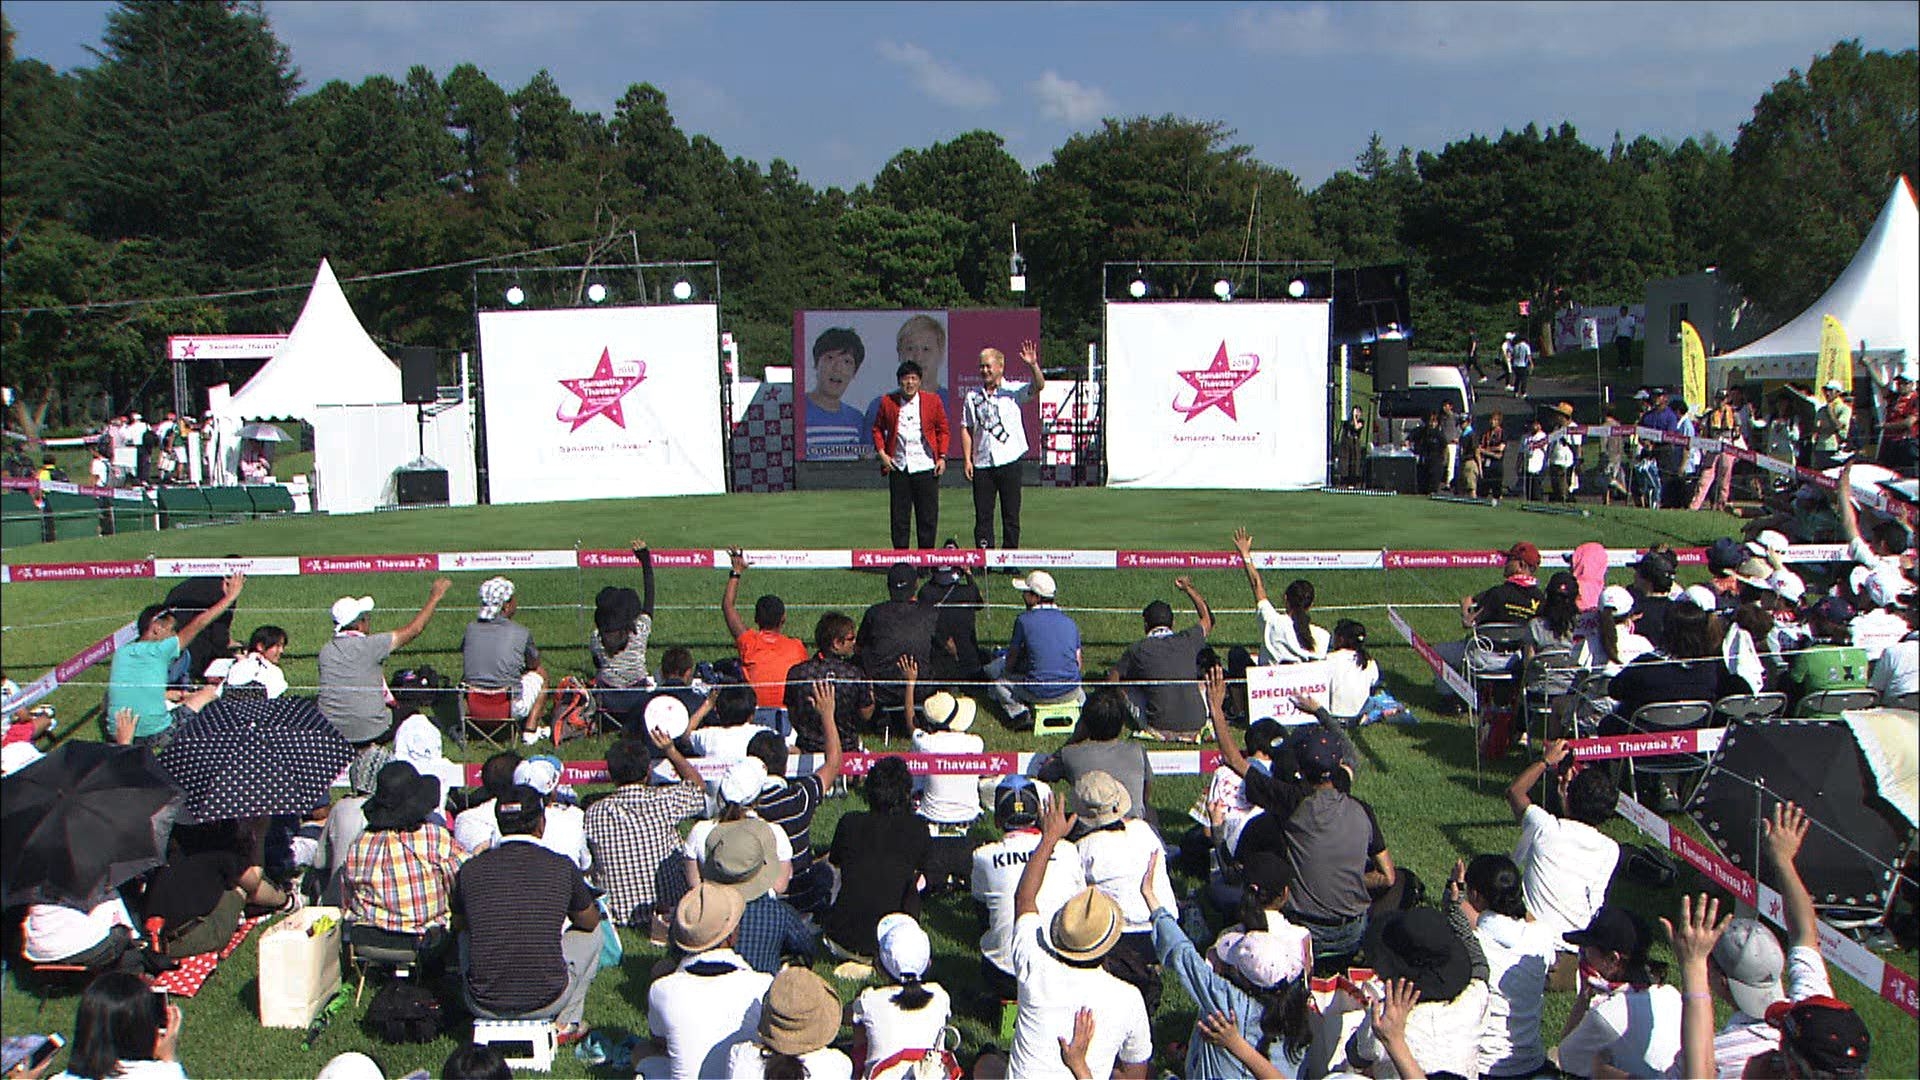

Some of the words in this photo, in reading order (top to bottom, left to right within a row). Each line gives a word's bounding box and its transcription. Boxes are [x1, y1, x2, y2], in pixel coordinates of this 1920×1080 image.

[1195, 371, 1238, 380] Samantha
[578, 378, 624, 388] Samantha
[1200, 380, 1234, 388] Thavasa
[585, 387, 621, 397] Thavasa
[652, 554, 692, 564] Thavasa
[875, 554, 922, 564] Samantha
[926, 554, 965, 563] Thavasa
[1139, 555, 1184, 565] Samantha
[1190, 555, 1227, 565] Thavasa
[1403, 555, 1447, 565] Samantha
[1452, 554, 1488, 564] Thavasa
[323, 560, 371, 570] Samantha
[377, 559, 415, 568] Thavasa
[34, 566, 85, 577] Samantha
[90, 565, 132, 575] Thavasa
[1251, 686, 1297, 699] SPECIAL
[1300, 683, 1327, 694] PASS
[1618, 740, 1667, 752] Thavasa
[935, 759, 987, 771] Thavasa
[1682, 842, 1712, 872] Samantha
[1714, 863, 1741, 891] Thavasa
